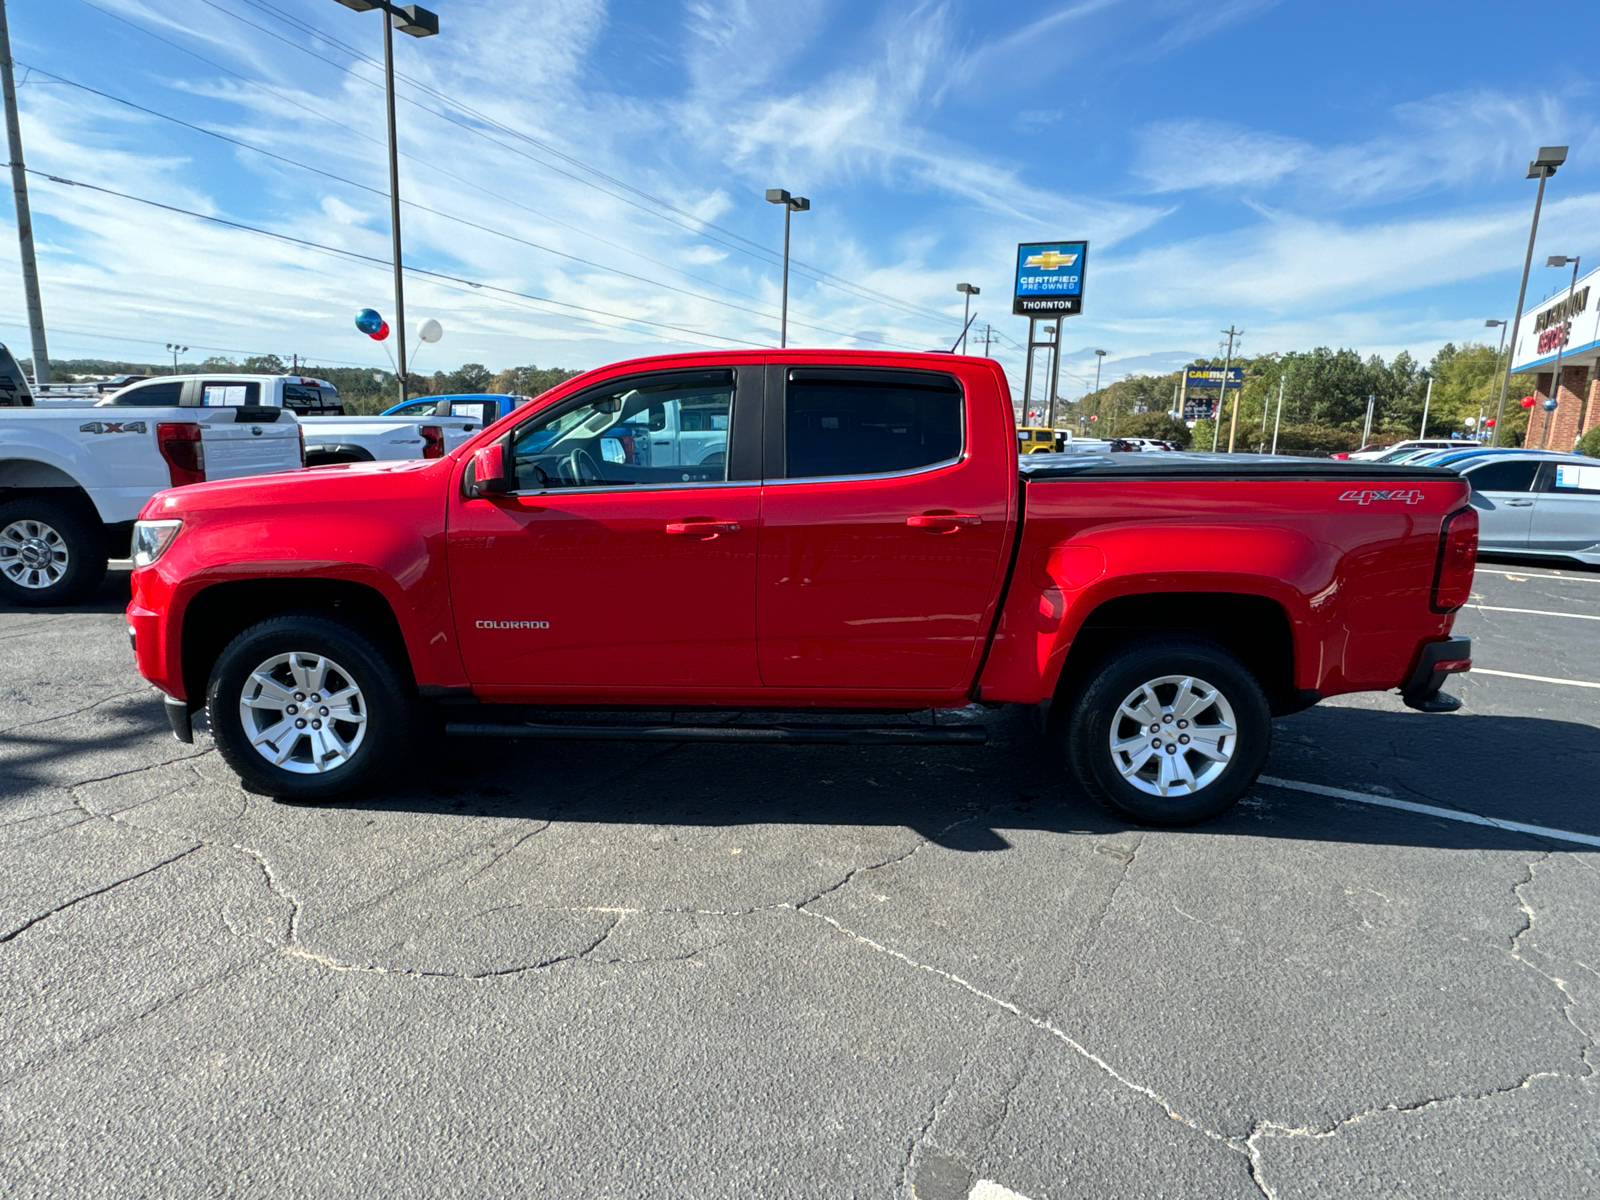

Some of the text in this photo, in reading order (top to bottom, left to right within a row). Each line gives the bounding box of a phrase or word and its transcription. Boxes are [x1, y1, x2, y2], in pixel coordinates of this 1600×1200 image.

[1020, 275, 1078, 284] CERTIFIED
[1023, 300, 1072, 309] THORNTON
[475, 620, 550, 629] COLORADO
